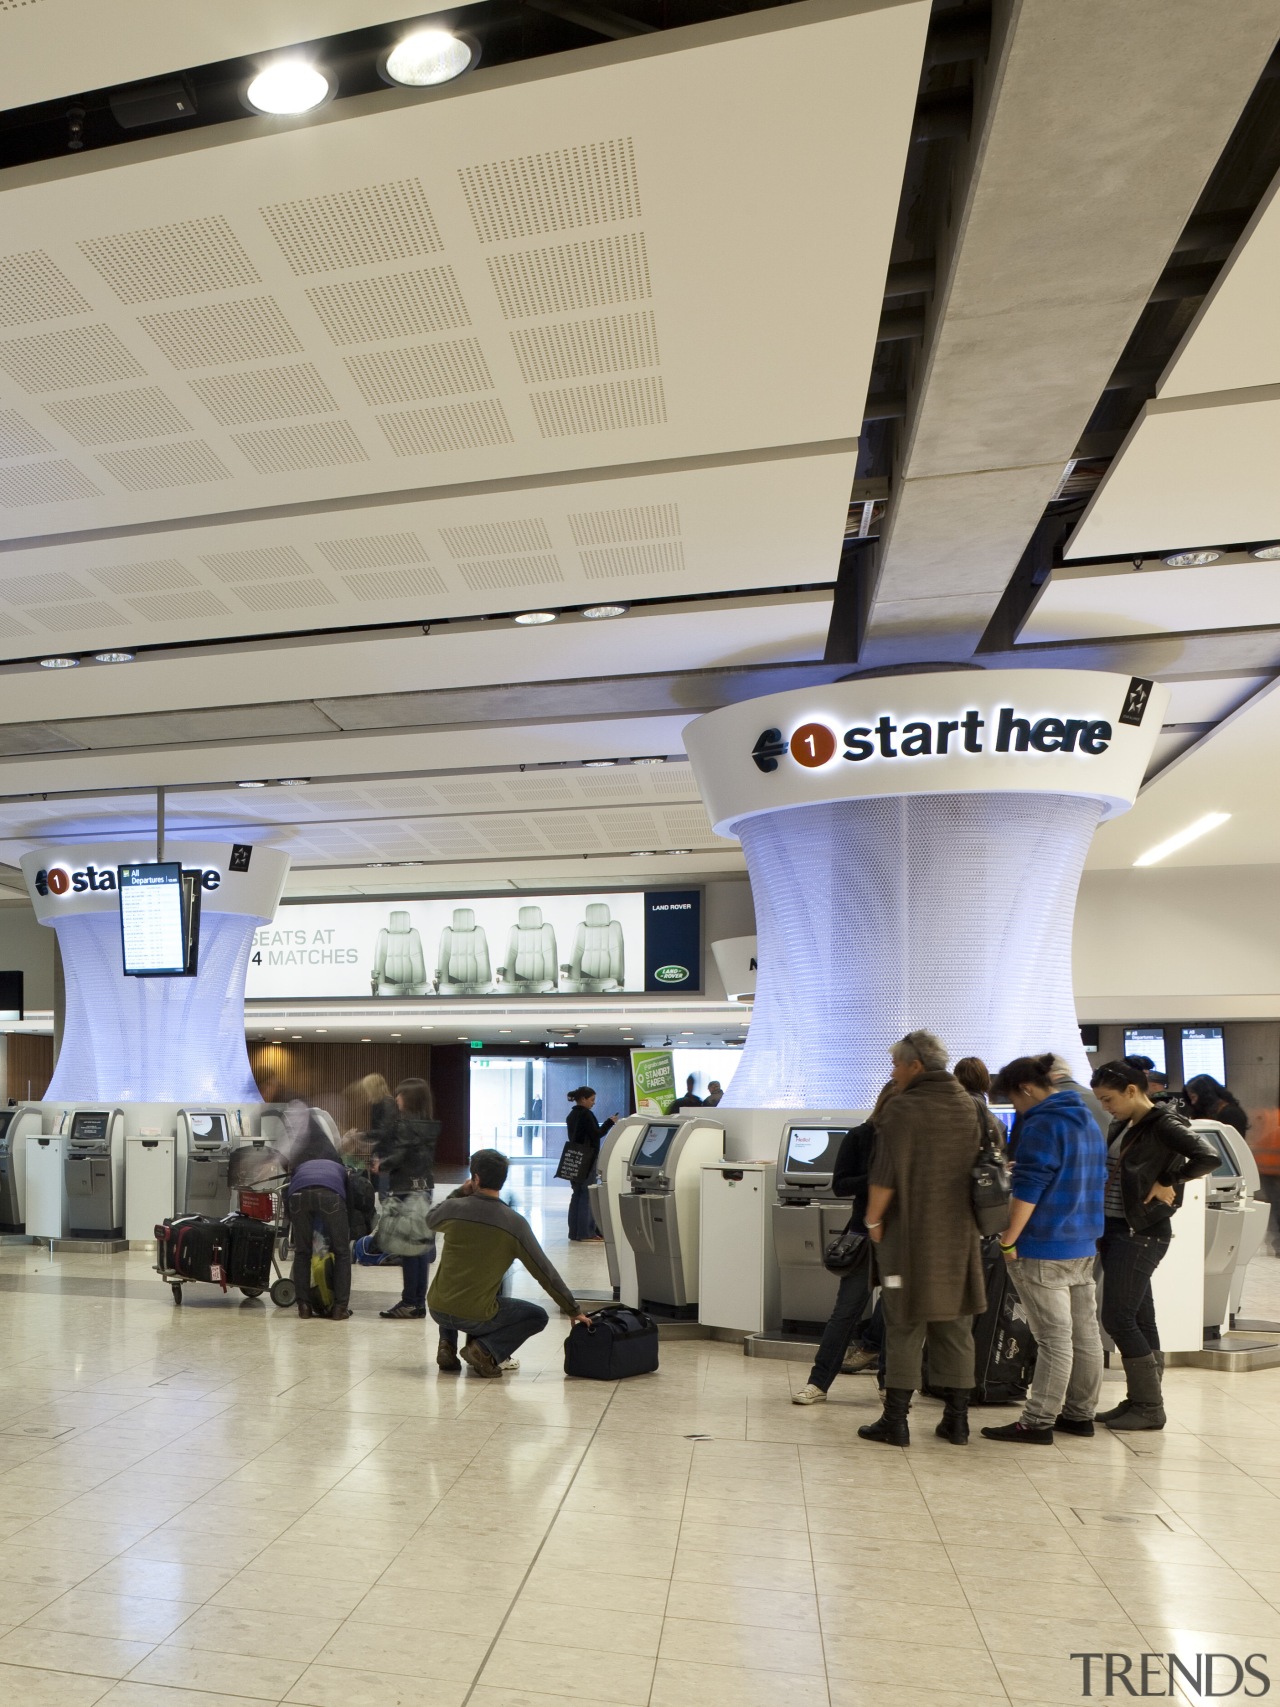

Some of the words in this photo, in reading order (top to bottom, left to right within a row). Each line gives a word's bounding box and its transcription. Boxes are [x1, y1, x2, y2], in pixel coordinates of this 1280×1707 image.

[842, 711, 985, 762] start
[995, 708, 1112, 755] here
[72, 866, 119, 892] sta
[131, 869, 140, 877] All
[131, 876, 164, 885] Departures
[670, 903, 692, 911] ROVER
[250, 930, 307, 947] SEATS
[312, 929, 335, 945] AT
[268, 948, 359, 966] MATCHES
[645, 1066, 670, 1080] STANDBY
[646, 1077, 666, 1088] FARES
